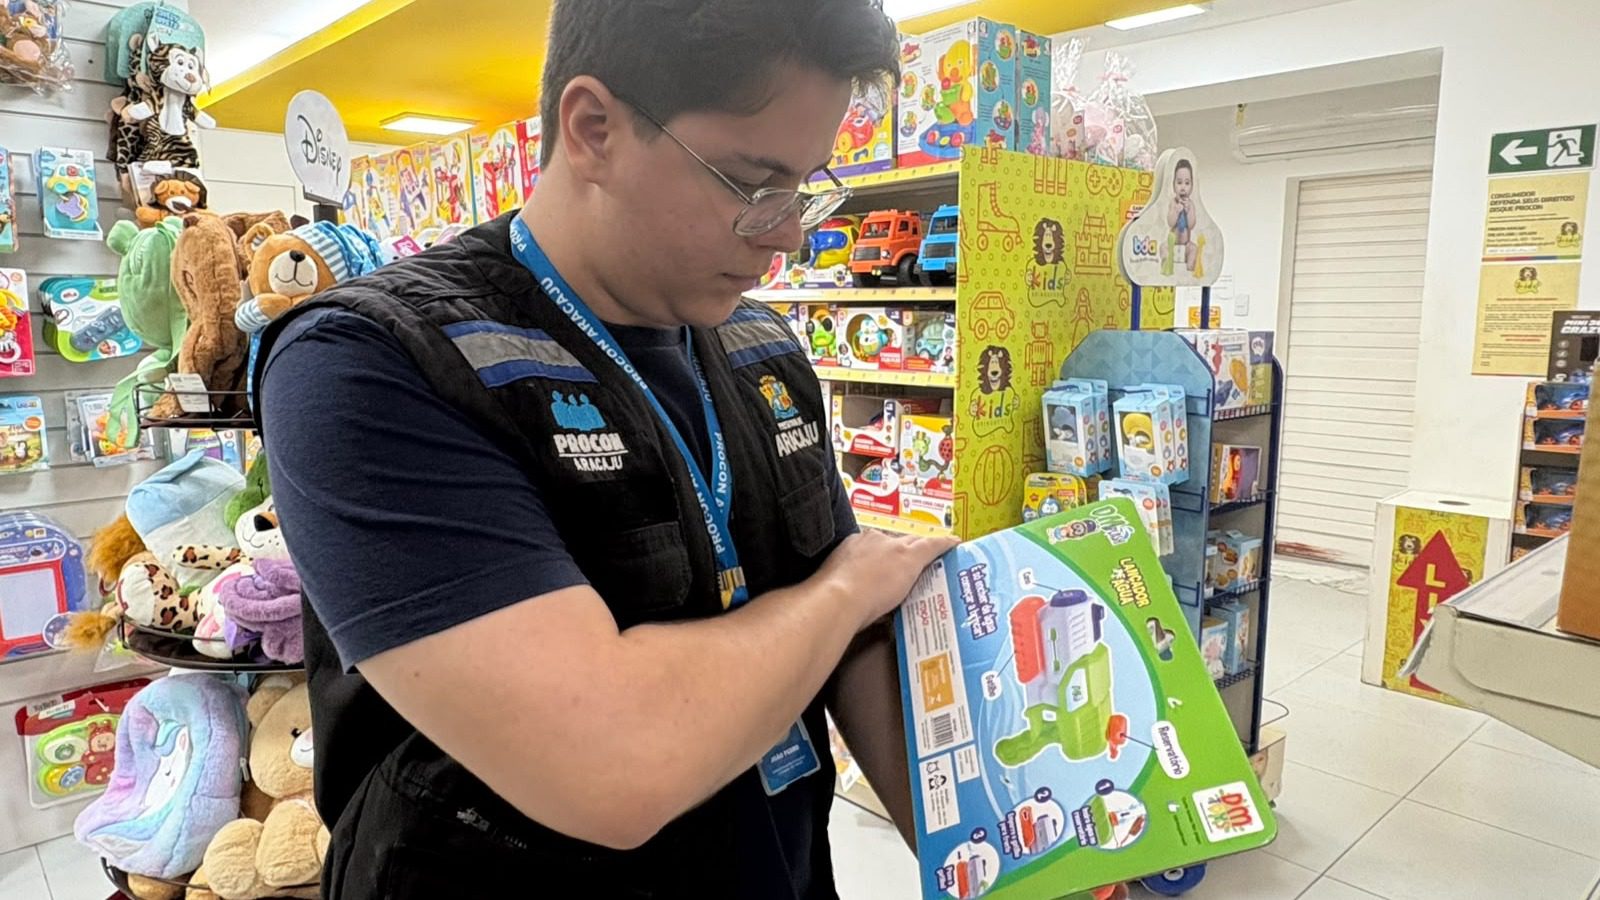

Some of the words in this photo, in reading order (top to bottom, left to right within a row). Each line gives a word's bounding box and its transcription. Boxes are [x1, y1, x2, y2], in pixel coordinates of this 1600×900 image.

[296, 113, 343, 187] Disney
[540, 276, 599, 338] ARACAJU
[597, 338, 648, 390] PROCON
[553, 432, 626, 453] PROCON
[572, 455, 624, 472] ARACAJU
[714, 431, 728, 494] PROCON
[1158, 726, 1184, 776] Reservatório
[1222, 792, 1252, 827] DM
